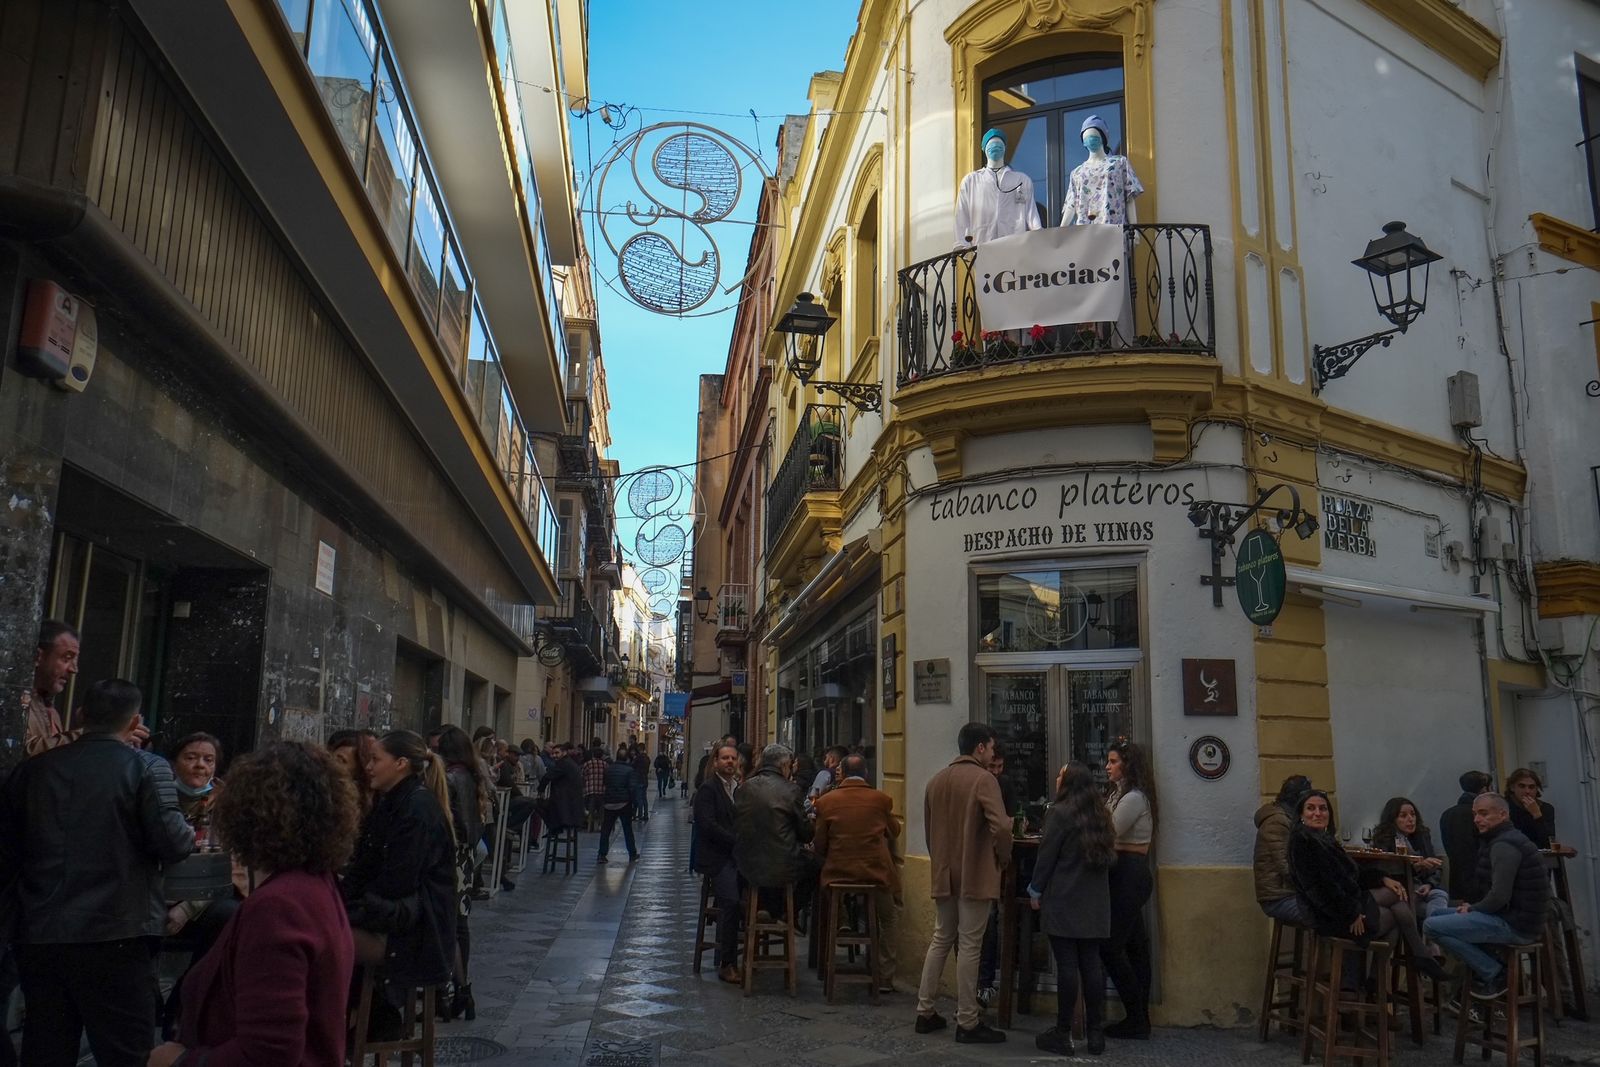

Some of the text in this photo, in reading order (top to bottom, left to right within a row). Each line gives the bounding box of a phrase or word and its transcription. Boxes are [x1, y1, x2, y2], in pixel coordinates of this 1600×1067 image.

[983, 258, 1120, 294] ¡Gracias!
[930, 473, 1194, 521] tabanco plateros
[1323, 495, 1375, 521] PLAZA
[963, 520, 1154, 552] DESPACHO DE VINOS
[1327, 531, 1376, 557] YERBA
[1001, 689, 1034, 701] TABANCO
[1081, 702, 1120, 713] PLATEROS
[1083, 689, 1118, 700] TABANCO
[999, 703, 1036, 714] PLATEROS
